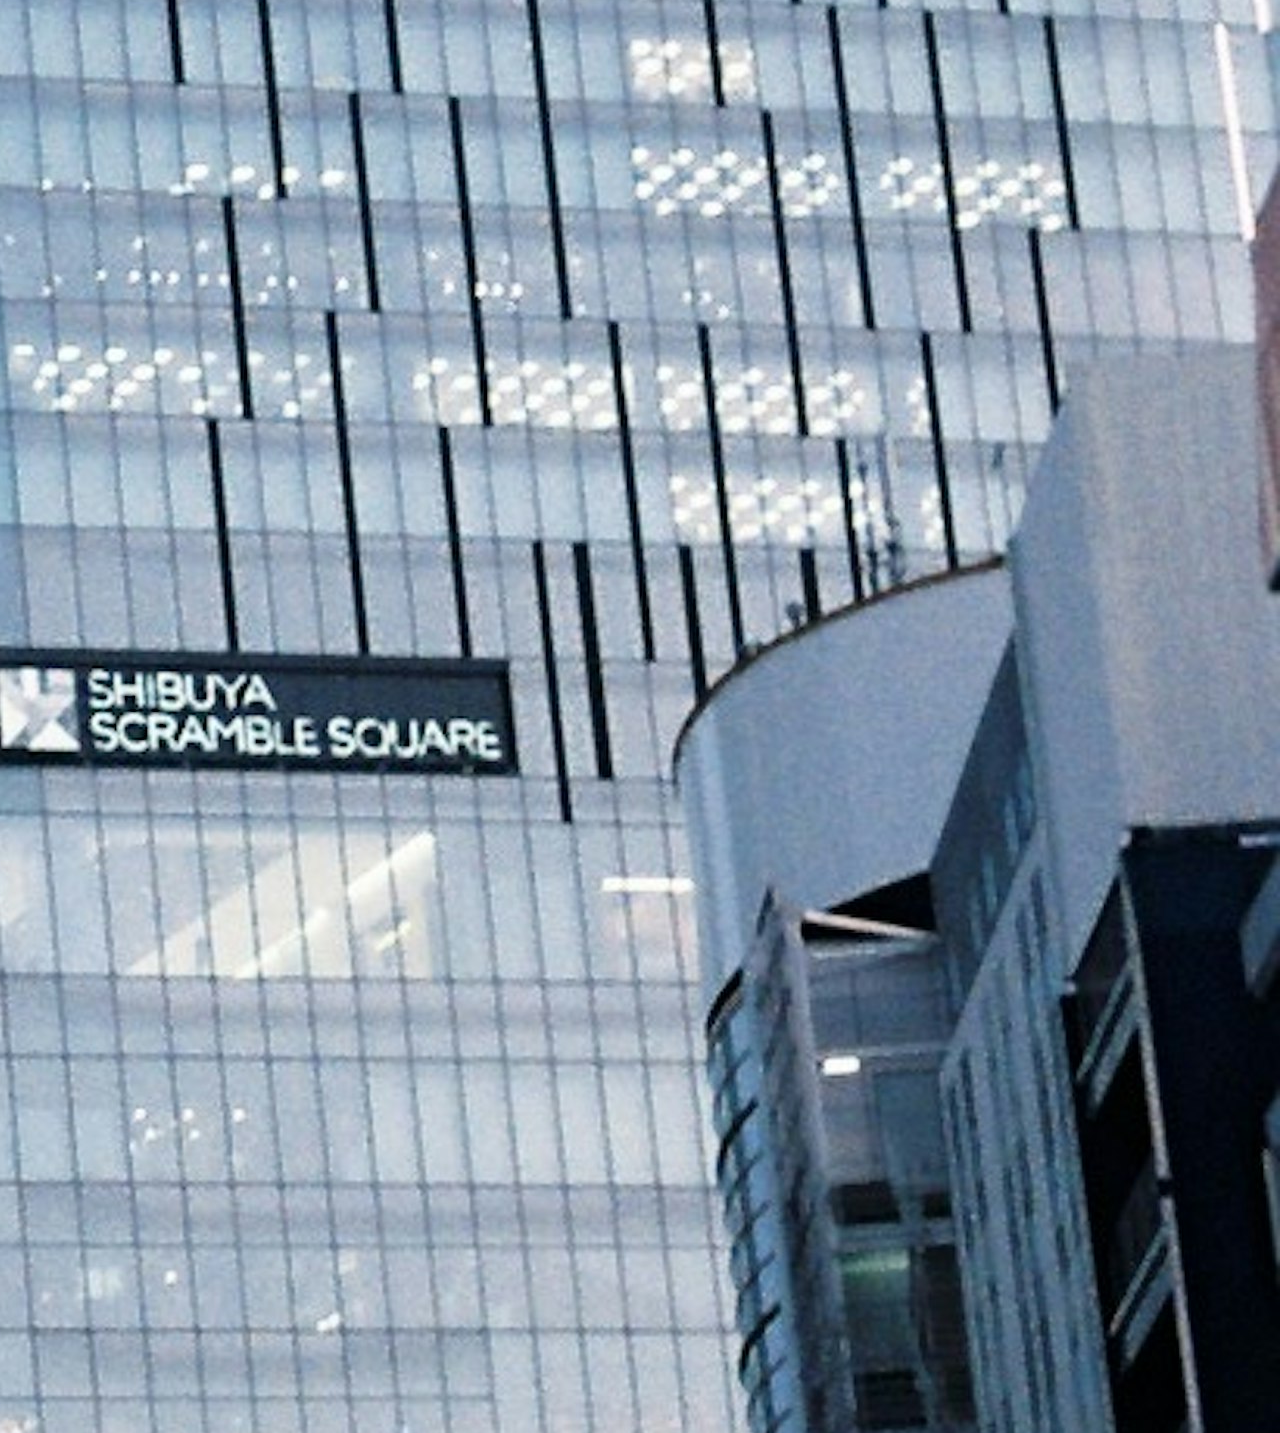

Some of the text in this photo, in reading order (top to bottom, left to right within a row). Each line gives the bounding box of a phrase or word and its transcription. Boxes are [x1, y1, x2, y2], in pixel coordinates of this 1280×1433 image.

[87, 668, 277, 712] SHIBUYA
[89, 711, 503, 760] SCRAMBLE SQUARE
